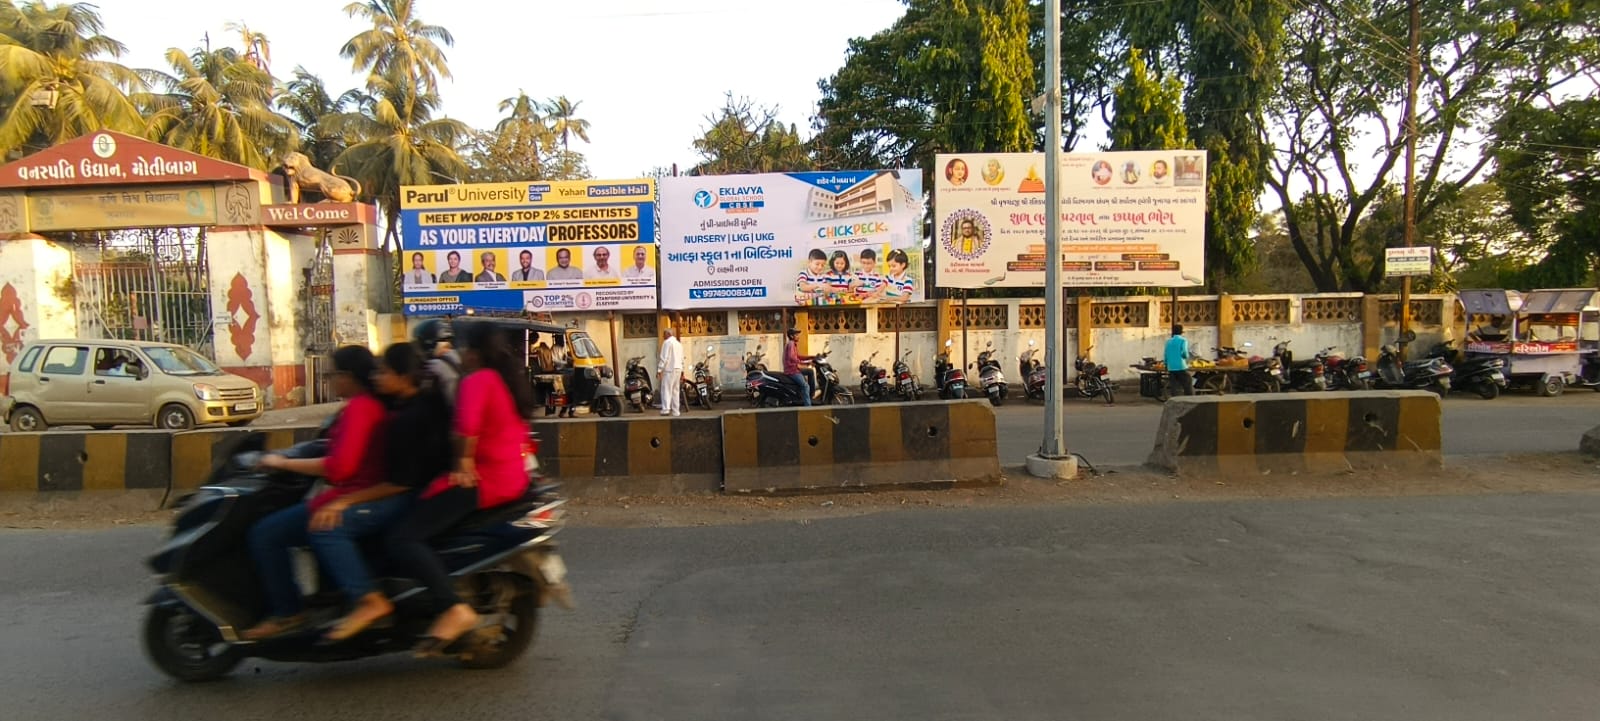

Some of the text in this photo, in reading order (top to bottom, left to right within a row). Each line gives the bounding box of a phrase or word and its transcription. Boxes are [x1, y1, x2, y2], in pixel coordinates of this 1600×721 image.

[18, 159, 76, 180] વનસ્પતિ
[131, 156, 199, 176] મોતીબાગ
[457, 186, 526, 203] University
[558, 185, 648, 197] Yahan Possible Hai!
[719, 186, 764, 196] EKLAVYA
[426, 208, 632, 224] MEET WORLD'S TOP 2% SCIENTISTS
[1010, 213, 1033, 225] શુભ
[1148, 208, 1176, 225] ભોગ
[420, 223, 638, 246] AS YOUR EVERYDAY PROFESSORS
[684, 232, 774, 244] NURSERY LKG UKG
[668, 252, 698, 264] આલ્ફા
[730, 251, 742, 260] ના
[693, 278, 762, 288] ADMISSIONS OPEN
